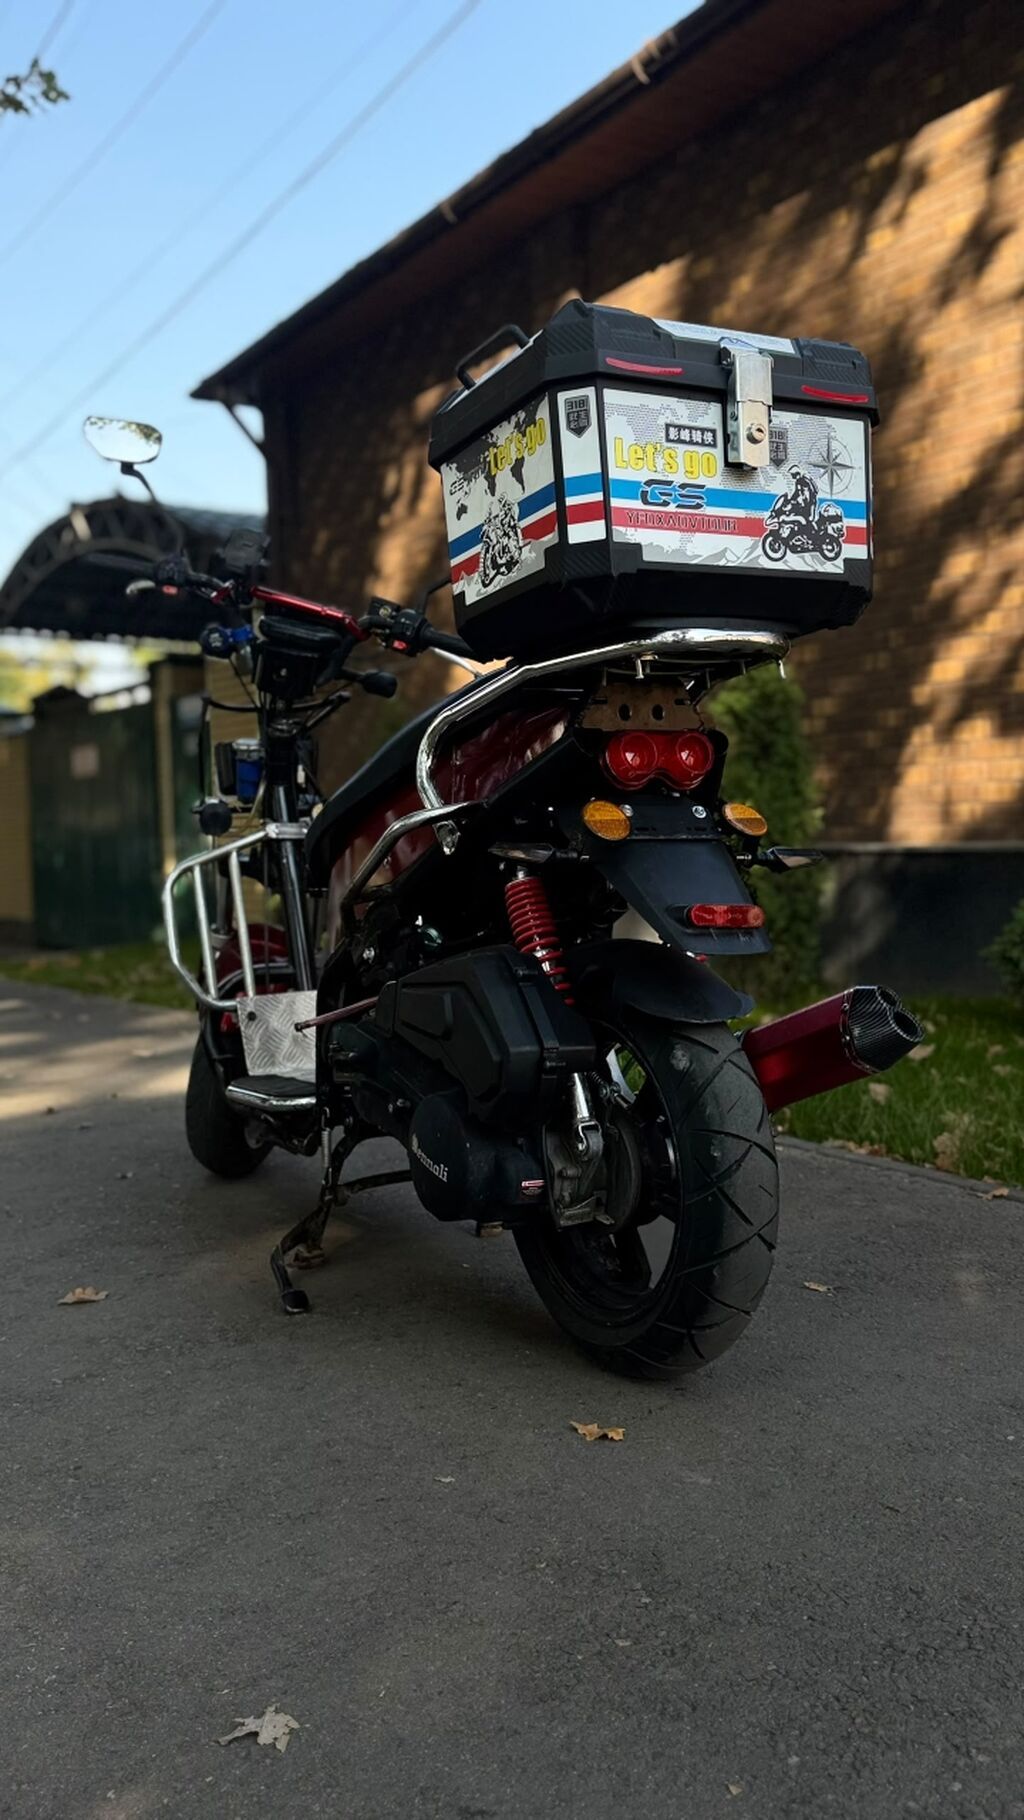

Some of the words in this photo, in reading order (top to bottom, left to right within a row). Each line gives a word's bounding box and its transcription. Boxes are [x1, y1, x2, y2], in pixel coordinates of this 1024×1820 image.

[488, 433, 525, 476] Let's
[525, 417, 547, 458] go
[614, 436, 679, 474] Let's
[683, 451, 718, 479] go
[639, 478, 707, 510] GS
